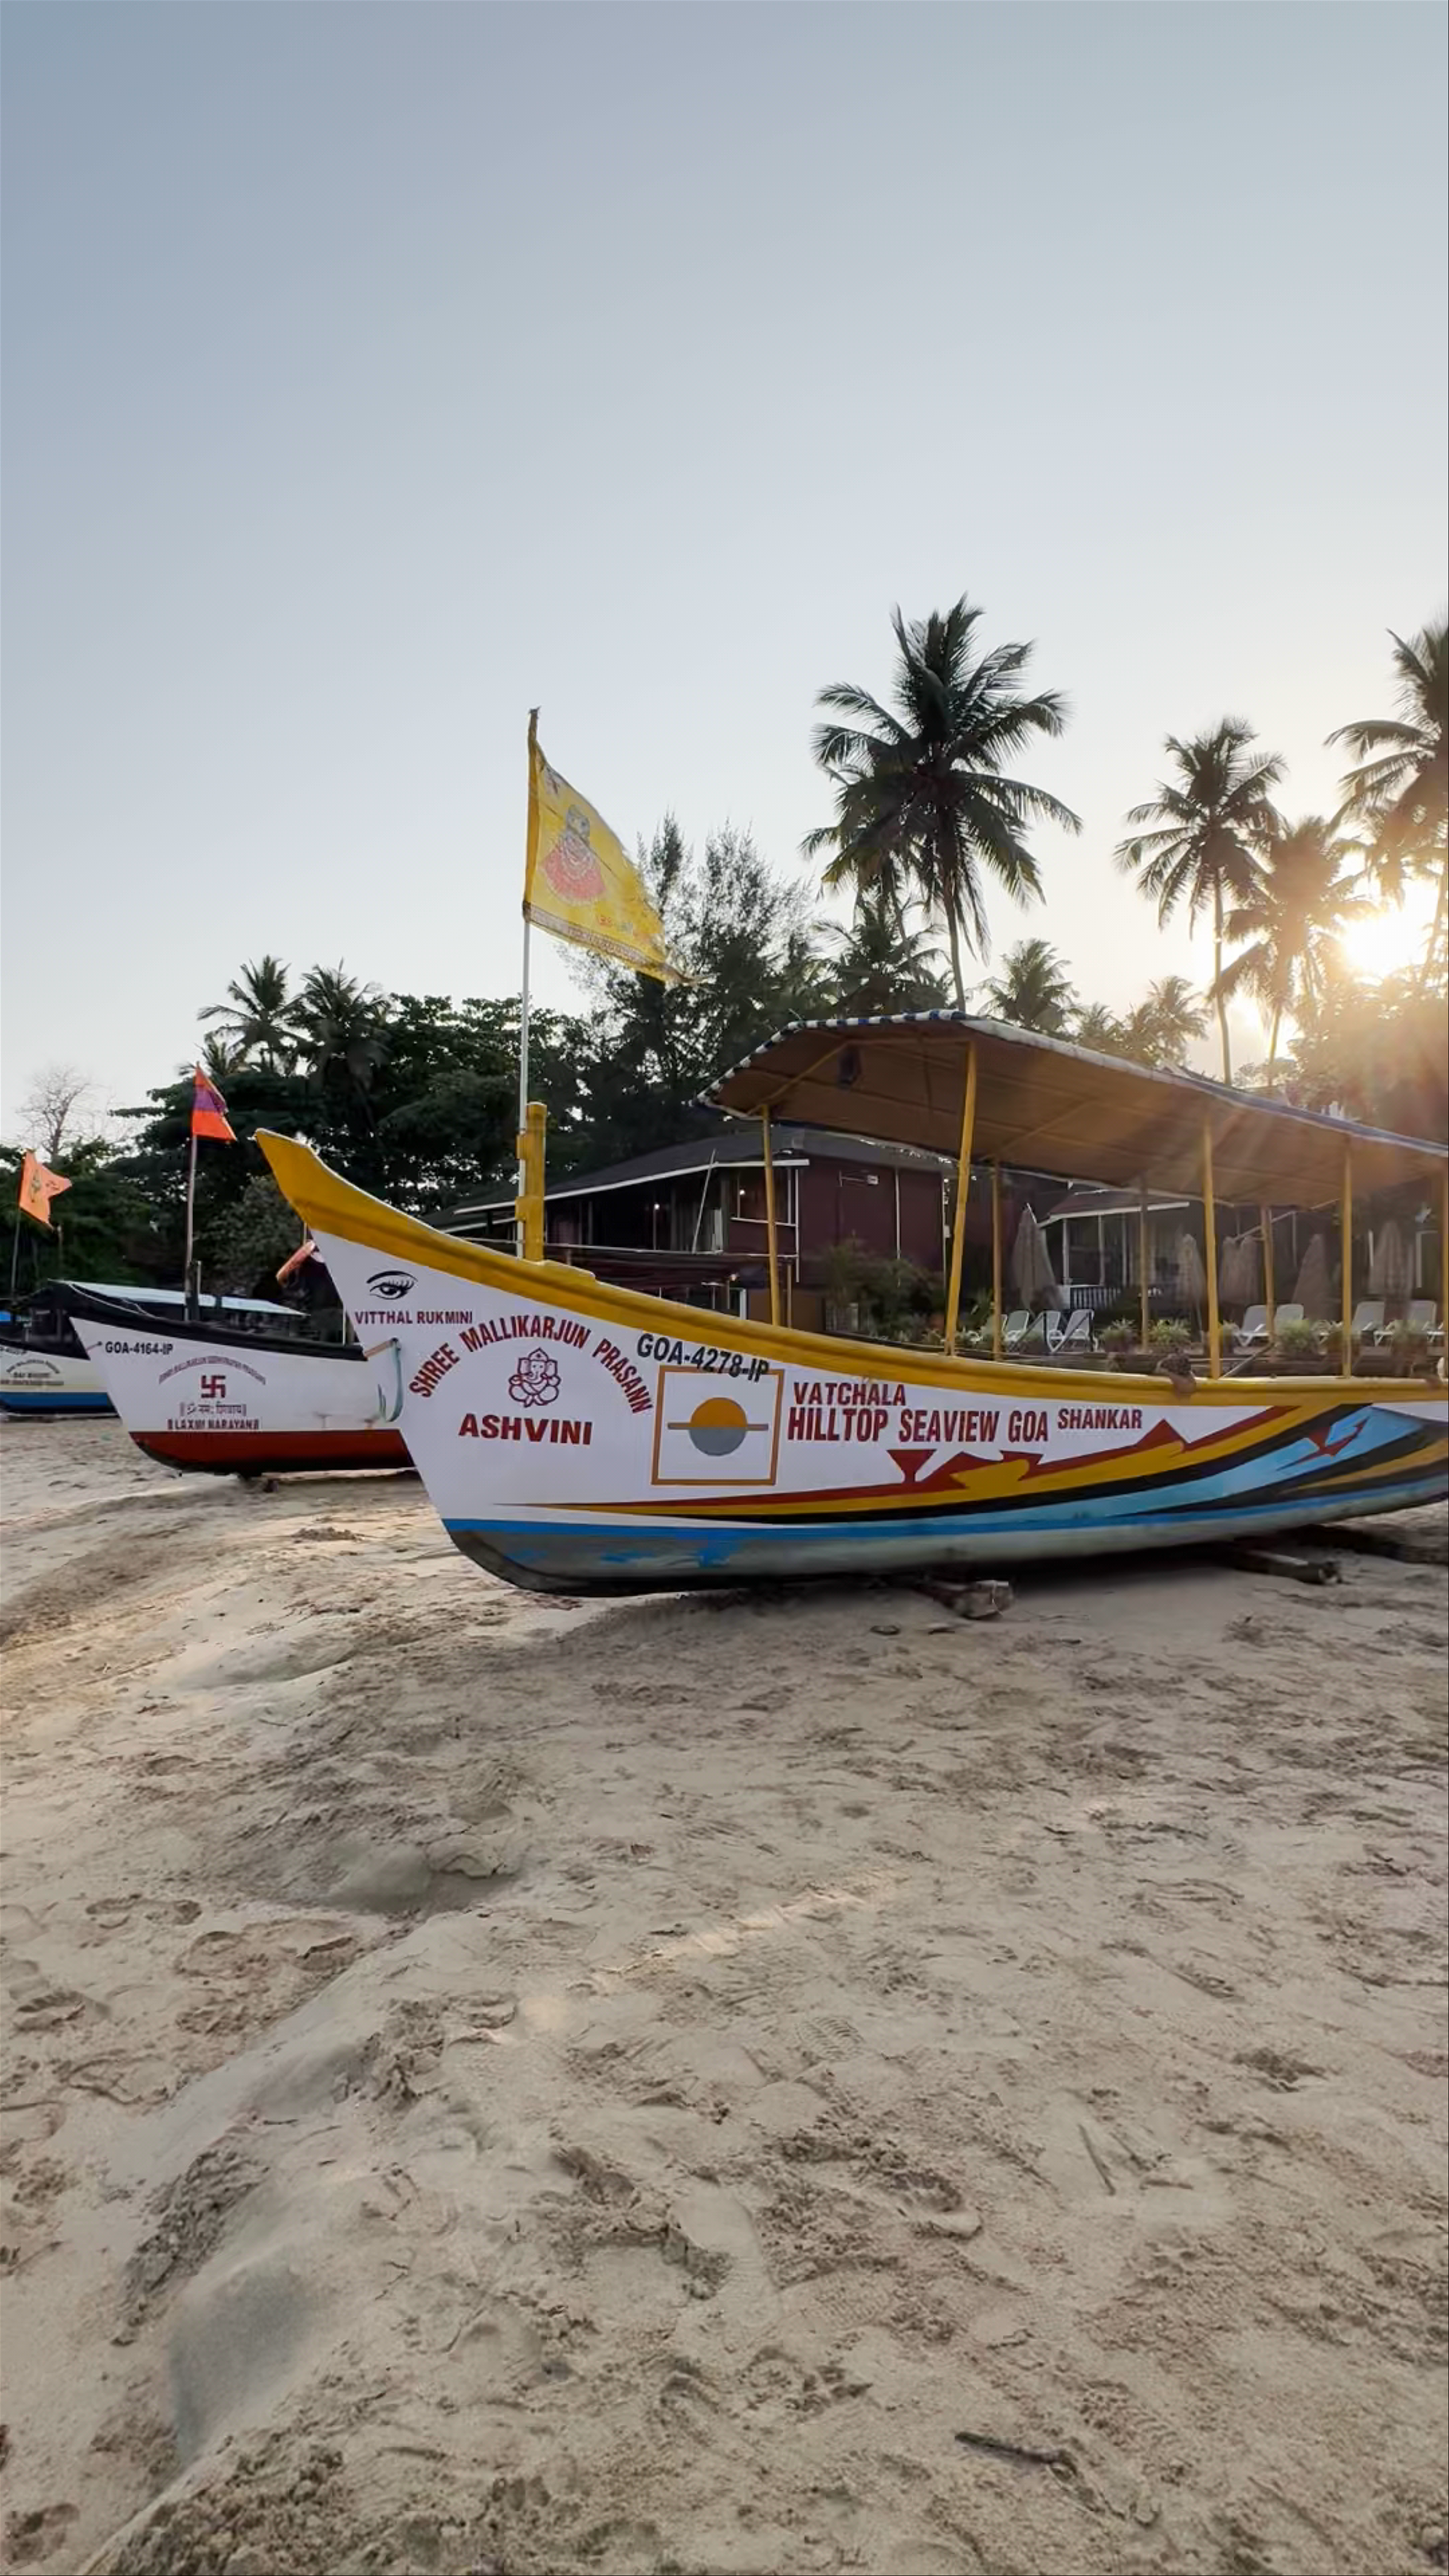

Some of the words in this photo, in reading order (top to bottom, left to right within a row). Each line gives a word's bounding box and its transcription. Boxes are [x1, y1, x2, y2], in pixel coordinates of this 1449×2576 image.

[355, 1311, 413, 1324] VITTHAL
[417, 1311, 472, 1324] RUKMINI
[409, 1343, 460, 1398] SHREE
[459, 1315, 591, 1353] MALLIKARJUN
[592, 1338, 654, 1414] PRASANN
[637, 1333, 769, 1382] GOA-4278-IP
[794, 1382, 906, 1406] VATCHALA
[458, 1413, 592, 1445] ASHVINI
[788, 1407, 888, 1442] HILLTOP
[898, 1409, 1000, 1443] SEAVIEW
[1008, 1410, 1049, 1443] GOA
[1057, 1408, 1143, 1430] SHANKAR
